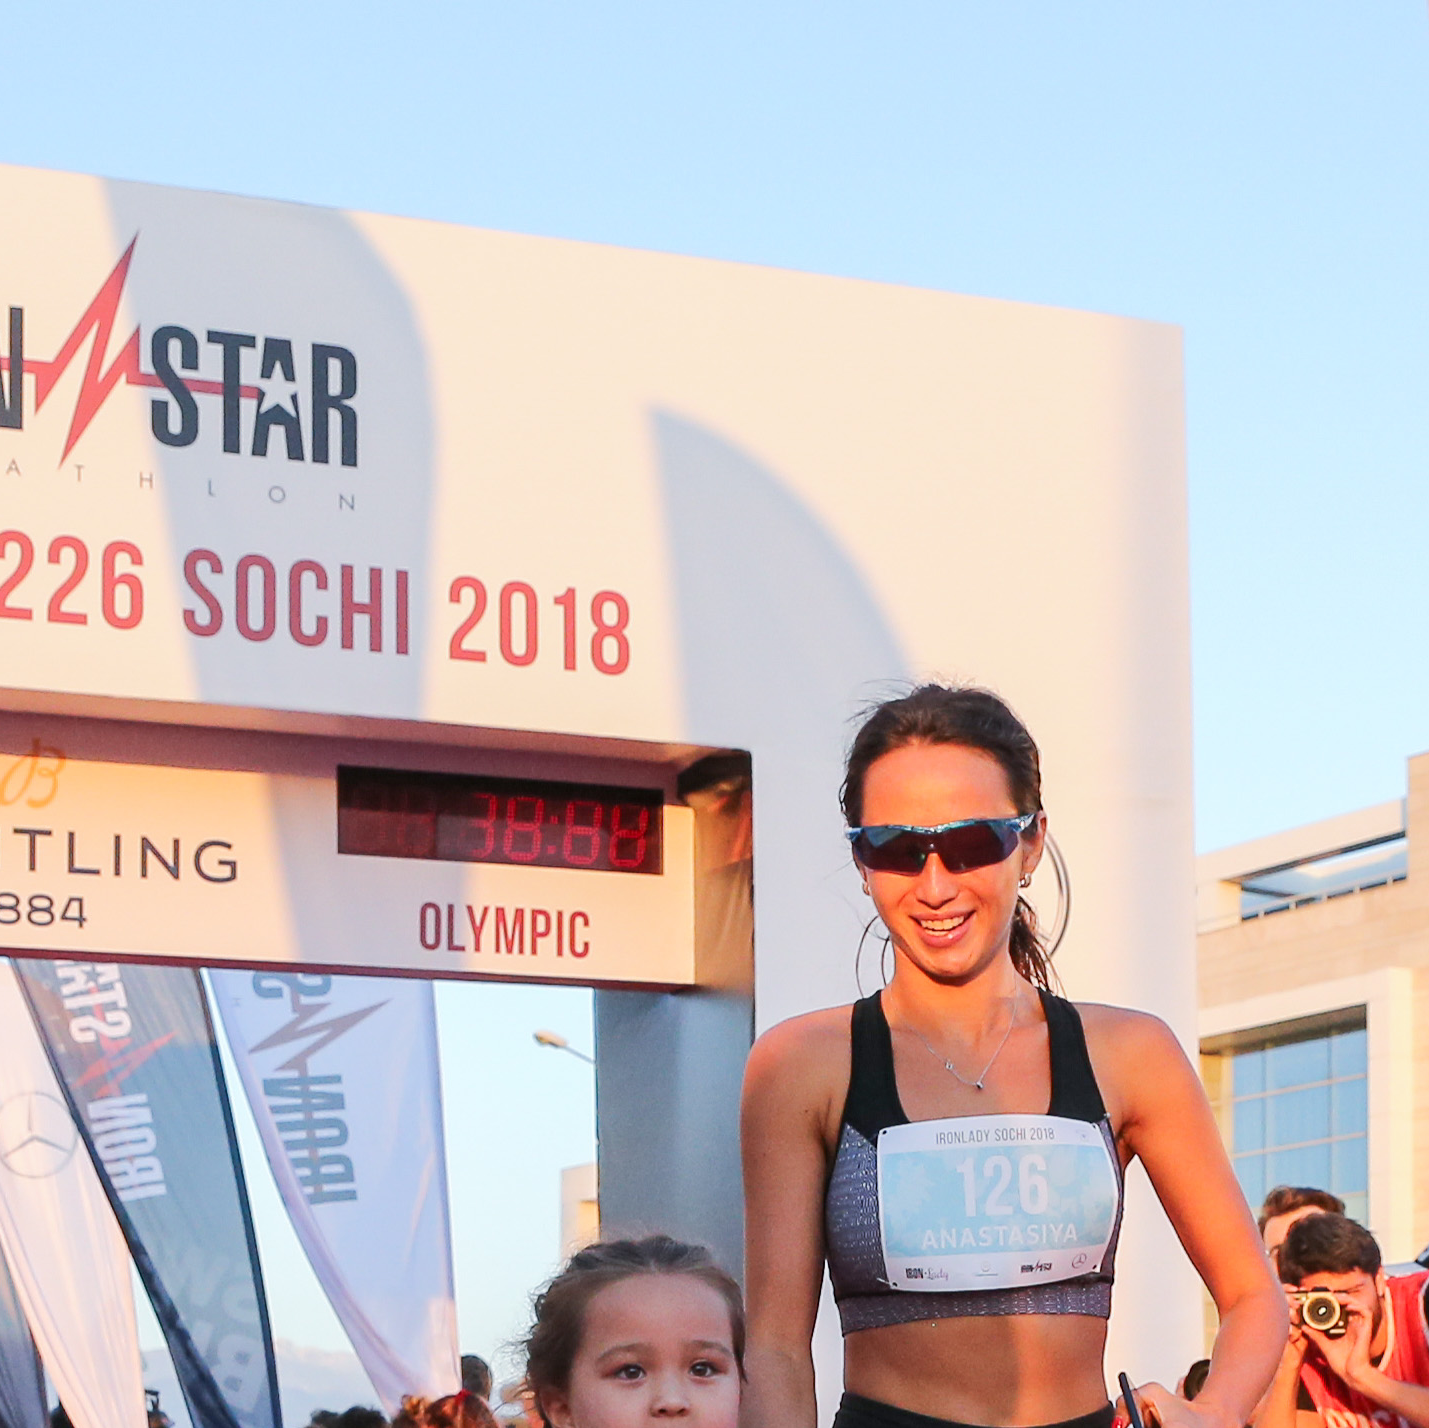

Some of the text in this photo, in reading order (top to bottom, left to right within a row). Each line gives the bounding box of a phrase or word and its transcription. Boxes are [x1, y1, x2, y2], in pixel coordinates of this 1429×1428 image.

[151, 323, 358, 467] STAR
[182, 547, 410, 656] SOCHI
[448, 575, 630, 676] 2018
[419, 901, 591, 959] OLYMPIC
[936, 1127, 1055, 1145] IRONLADY SOCHI 2018
[956, 1153, 1049, 1217] 126
[923, 1222, 1079, 1250] ANASTASIYA
